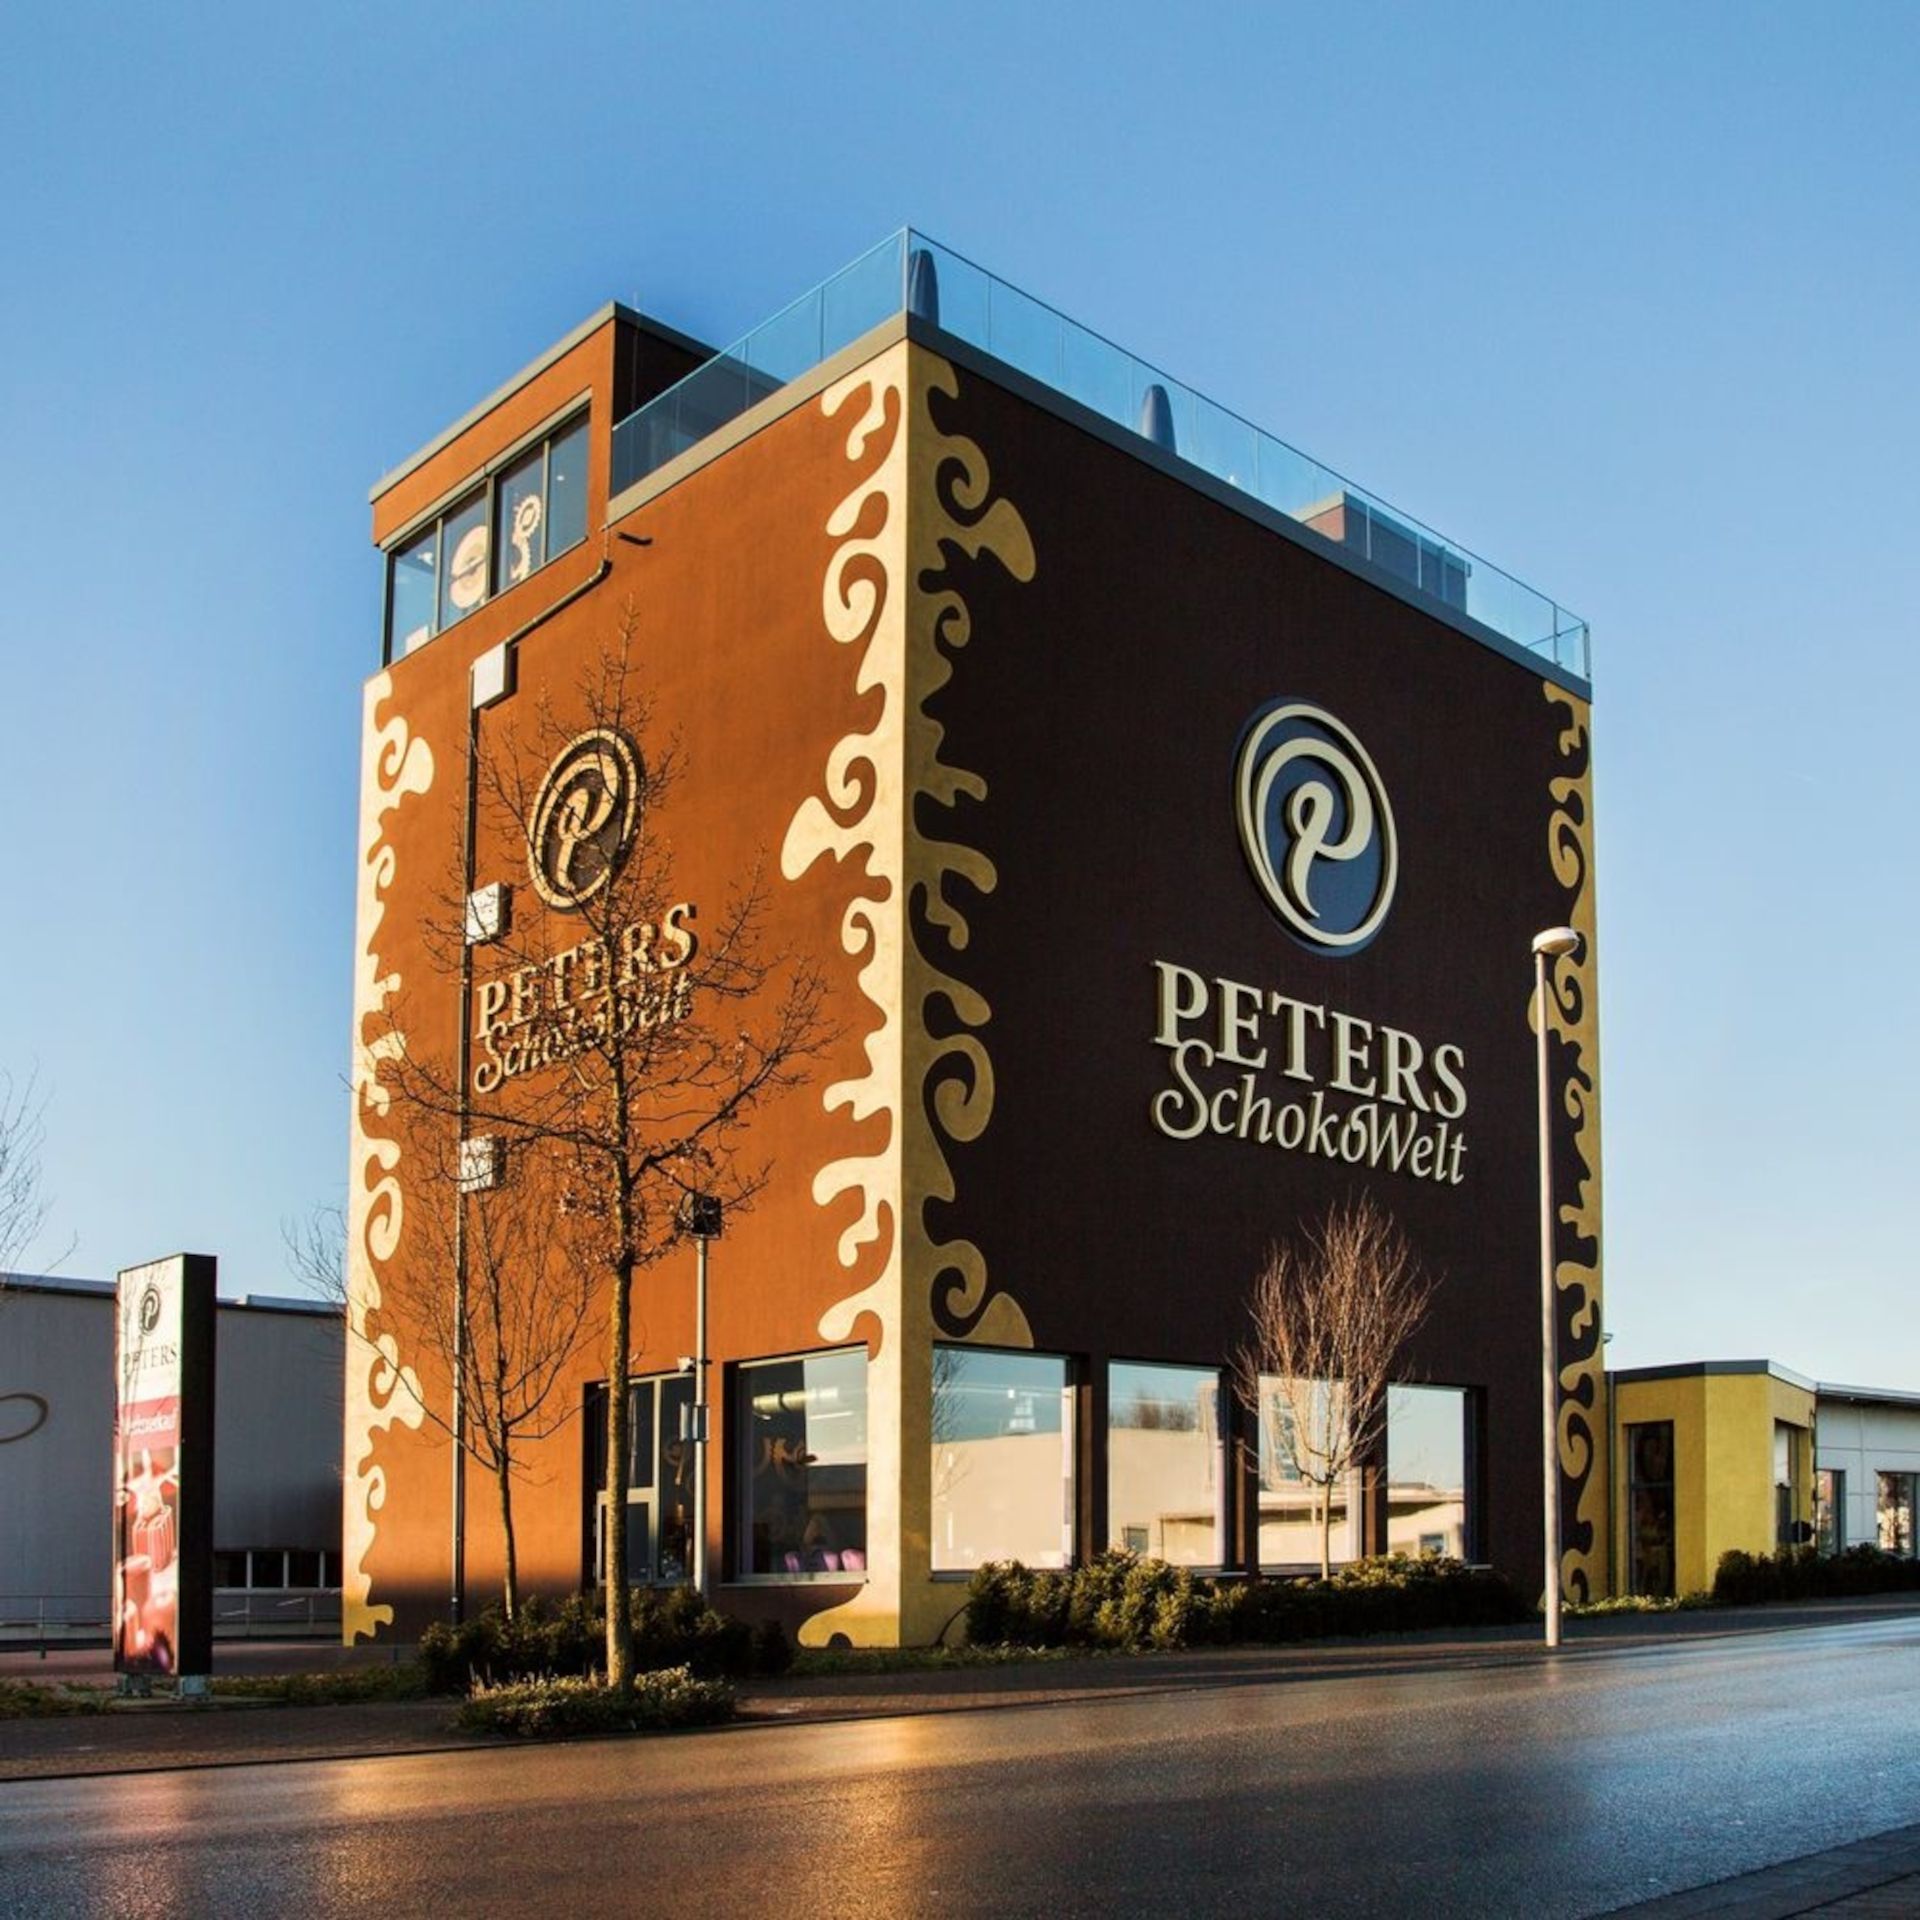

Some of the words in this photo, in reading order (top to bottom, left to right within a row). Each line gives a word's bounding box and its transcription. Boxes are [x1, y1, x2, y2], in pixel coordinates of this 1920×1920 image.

[474, 972, 694, 1093] Schoelt
[476, 903, 696, 1039] PETERS
[1152, 960, 1468, 1119] PETERS
[1152, 1039, 1468, 1184] SchokoWelt
